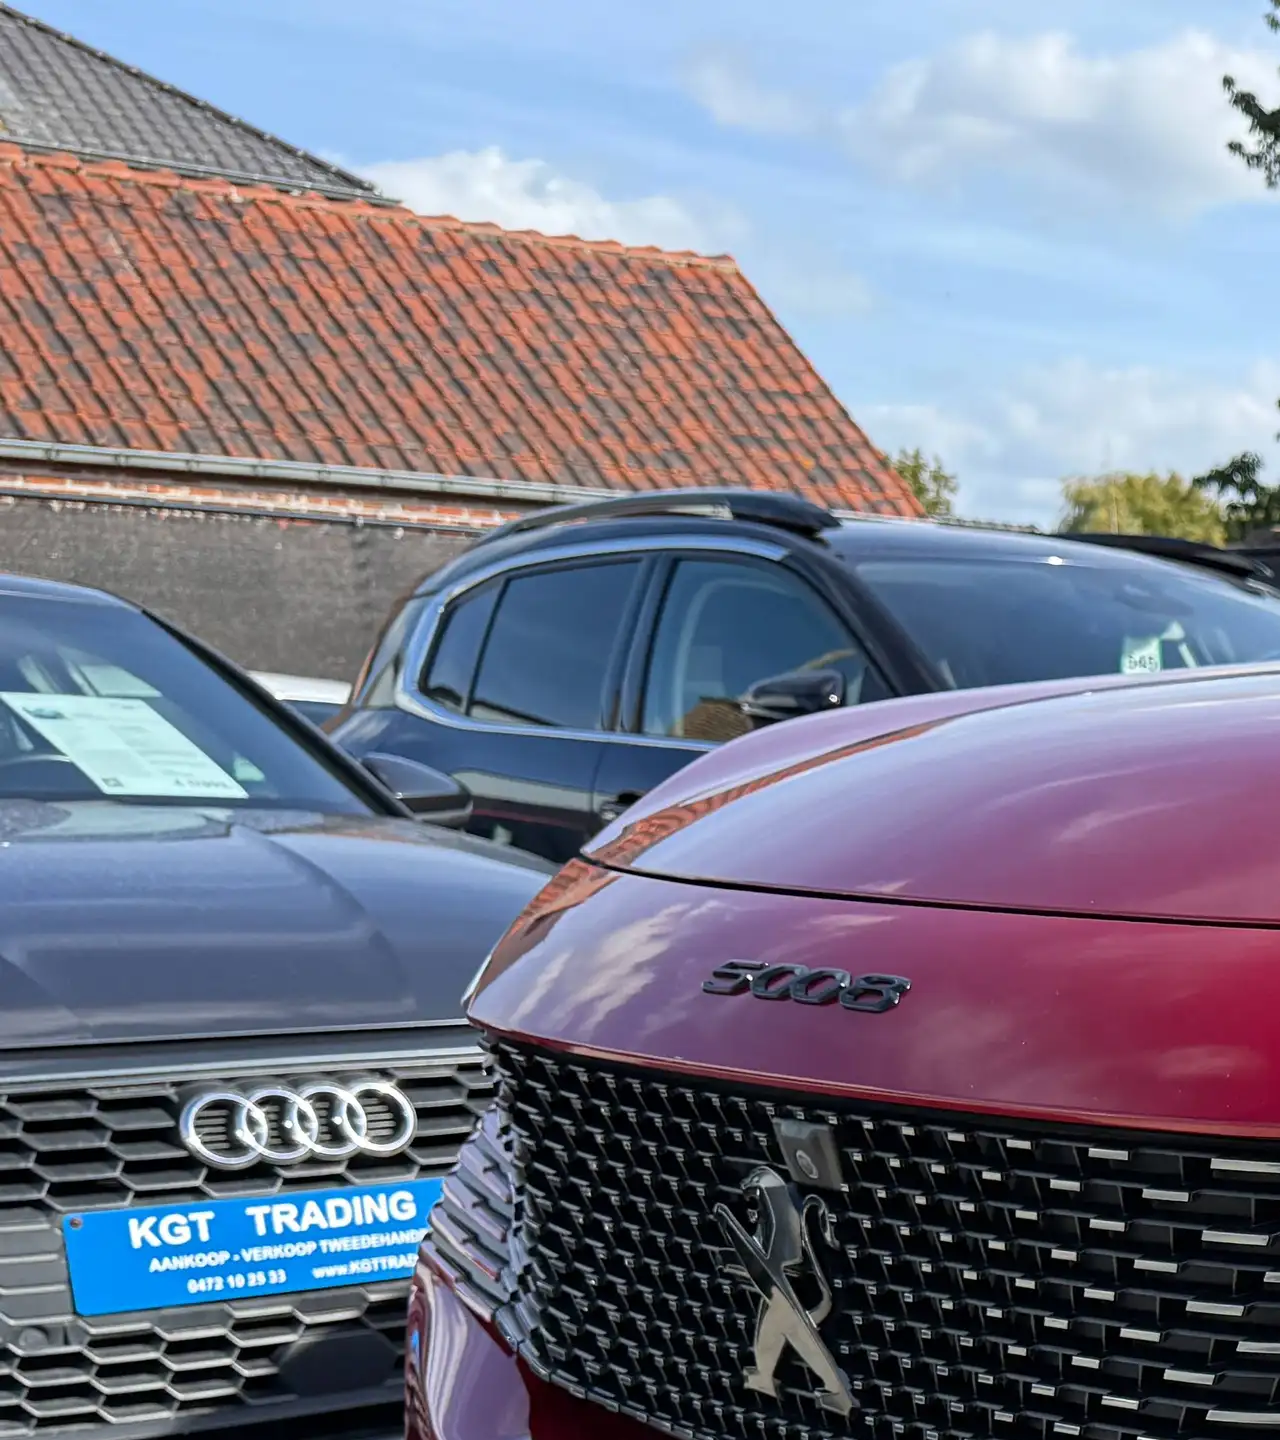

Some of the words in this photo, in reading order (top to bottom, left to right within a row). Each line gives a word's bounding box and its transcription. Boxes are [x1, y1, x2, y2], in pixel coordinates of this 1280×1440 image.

[701, 958, 912, 1013] 5008
[128, 1210, 216, 1249] KGT
[244, 1190, 417, 1236] TRADING
[148, 1250, 231, 1273] AANKOOP
[240, 1240, 318, 1262] VERKOOP
[311, 1252, 420, 1279] www.KGTTRAD
[227, 1273, 246, 1289] 10
